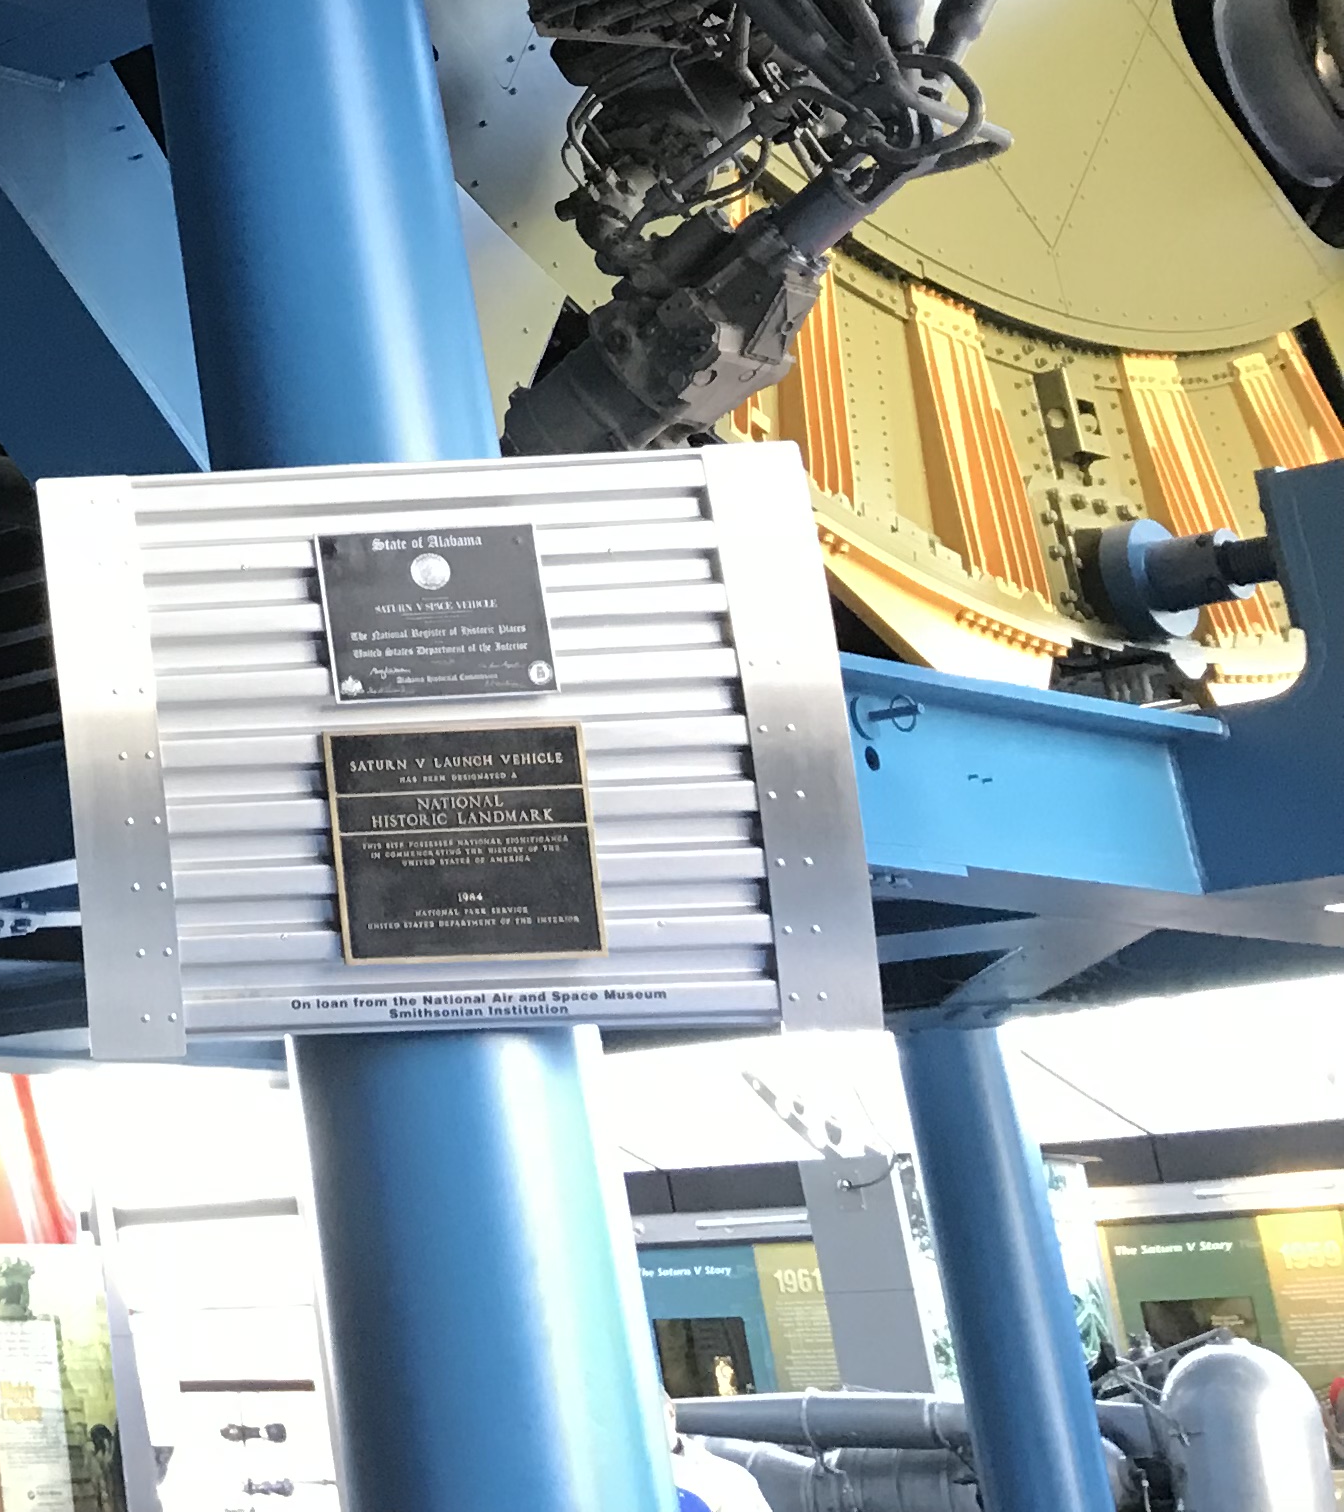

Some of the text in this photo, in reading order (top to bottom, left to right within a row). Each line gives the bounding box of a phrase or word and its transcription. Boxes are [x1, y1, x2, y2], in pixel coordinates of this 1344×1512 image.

[371, 535, 483, 552] State of Alabama
[374, 598, 498, 614] SATURN V SPACE VEHICLE
[350, 631, 368, 641] The
[372, 629, 408, 641] National
[411, 628, 446, 639] Register
[449, 626, 458, 637] of
[461, 625, 495, 637] Historic
[352, 641, 528, 659] United States Department of the Interior
[350, 751, 564, 773] SATURN V LAUNCH VEHICLE
[399, 776, 418, 784] HAS
[422, 775, 446, 783] BEEN
[451, 771, 507, 781] DESIGNATED
[417, 795, 504, 811] NATIONAL
[372, 808, 554, 829] HISTORIC LANDMARK
[457, 837, 502, 847] NATIONAL
[465, 847, 483, 855] THE
[487, 846, 524, 854] HISTORY
[527, 845, 539, 853] OF
[401, 854, 531, 867] UNITED STATES OF AMERICA
[415, 906, 528, 917] NATIONAL PARK SERVICE
[367, 915, 580, 930] UNITED STATES DEPARTMENT OF THE INTERIOR
[291, 989, 667, 1010] On loan from the National Air and Space Museum
[389, 1004, 569, 1019] Smithsonian Institution
[1114, 1245, 1138, 1256] The
[1141, 1244, 1183, 1255] Saturn
[1186, 1242, 1196, 1252] V
[1199, 1240, 1233, 1253] Story
[1279, 1240, 1343, 1270] 1959
[640, 1267, 654, 1278] he
[657, 1266, 692, 1277] Saturn
[694, 1266, 703, 1276] V
[705, 1265, 732, 1278] Story
[773, 1268, 824, 1293] 1961
